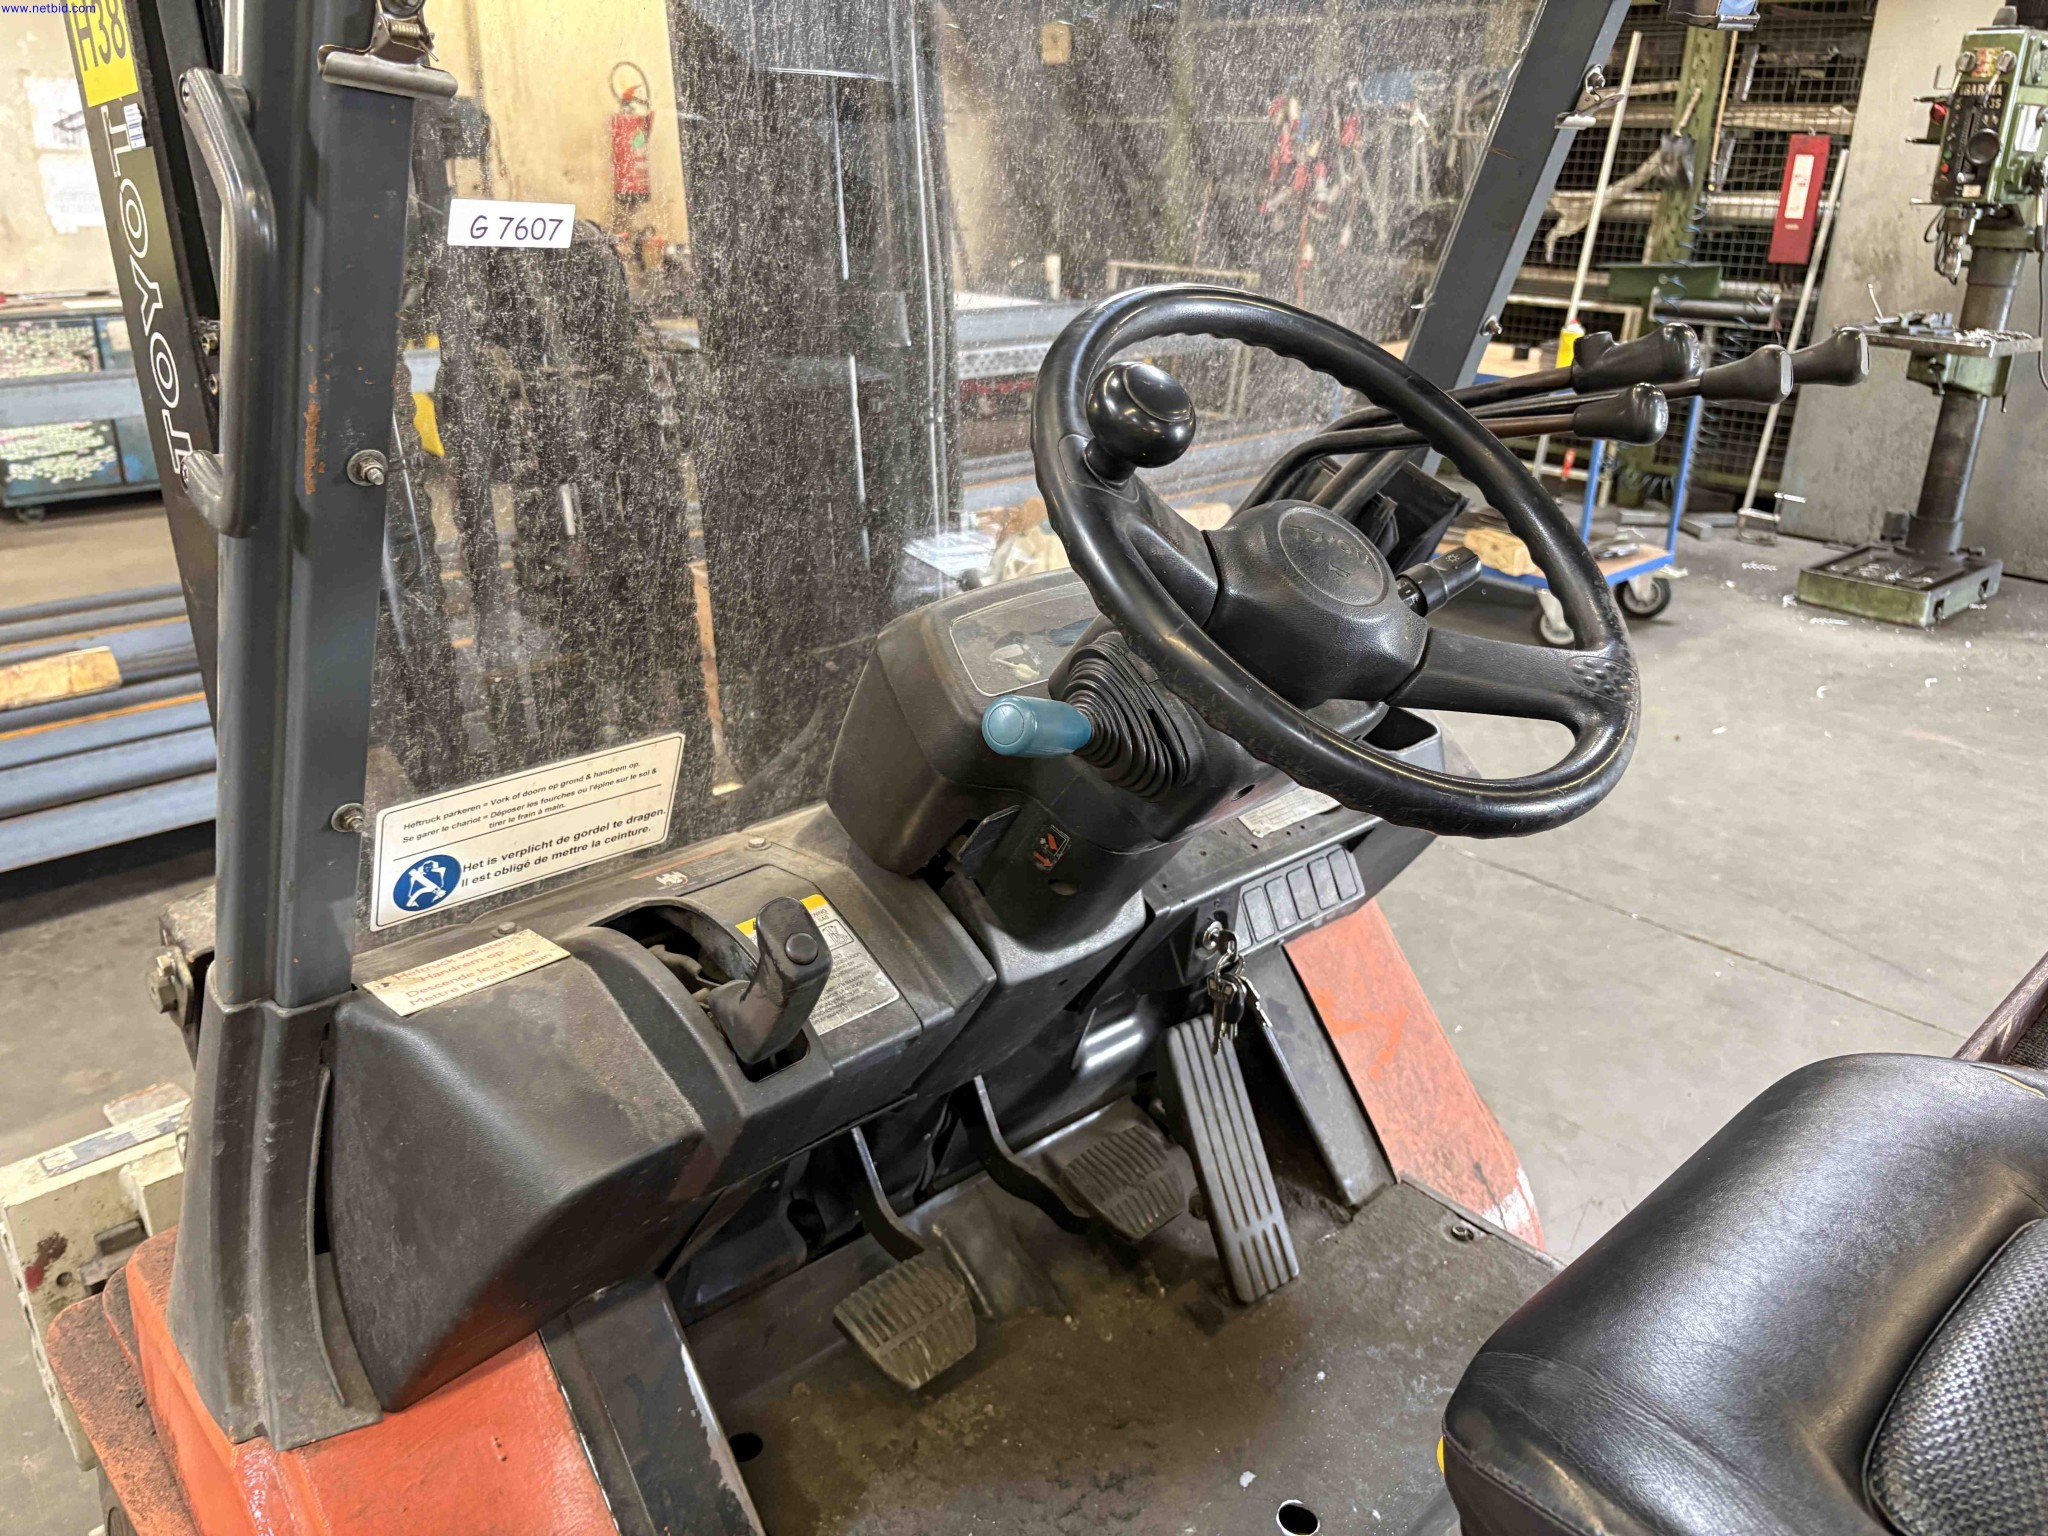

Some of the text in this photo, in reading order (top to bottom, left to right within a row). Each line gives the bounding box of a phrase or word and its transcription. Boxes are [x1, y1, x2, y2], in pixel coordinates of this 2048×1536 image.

[71, 0, 126, 71] H38
[470, 215, 564, 241] G 7607
[101, 104, 193, 475] TOYOT
[402, 835, 415, 844] Se
[416, 827, 440, 841] garer
[442, 825, 450, 833] le
[451, 816, 482, 830] chariot
[490, 804, 526, 820] Déposer
[526, 800, 539, 808] les
[540, 790, 576, 804] fourches
[577, 787, 588, 795] ou
[638, 769, 650, 777] sol
[403, 815, 441, 831] Heftruck
[443, 804, 481, 821] parkeren
[490, 795, 510, 806] Vork
[511, 792, 521, 800] of
[522, 786, 547, 798] doorn
[548, 783, 559, 792] op
[560, 775, 584, 789] grond
[593, 764, 627, 779] handrem
[629, 761, 641, 770] op.
[488, 820, 507, 829] tirer
[517, 811, 536, 821] frain
[544, 803, 567, 813] main.
[462, 808, 666, 873] Het is verplicht de gordel te dragen.
[472, 873, 491, 884] est
[494, 860, 531, 877] obligé
[534, 855, 548, 865] de
[551, 843, 588, 860] mettre
[591, 839, 601, 848] la
[604, 826, 652, 844] ceinture.
[391, 957, 455, 981] Heftruck
[405, 949, 540, 998] Descende le chariot
[409, 952, 553, 1006] Mettre le frain à main
[419, 950, 505, 982] Handrem op
